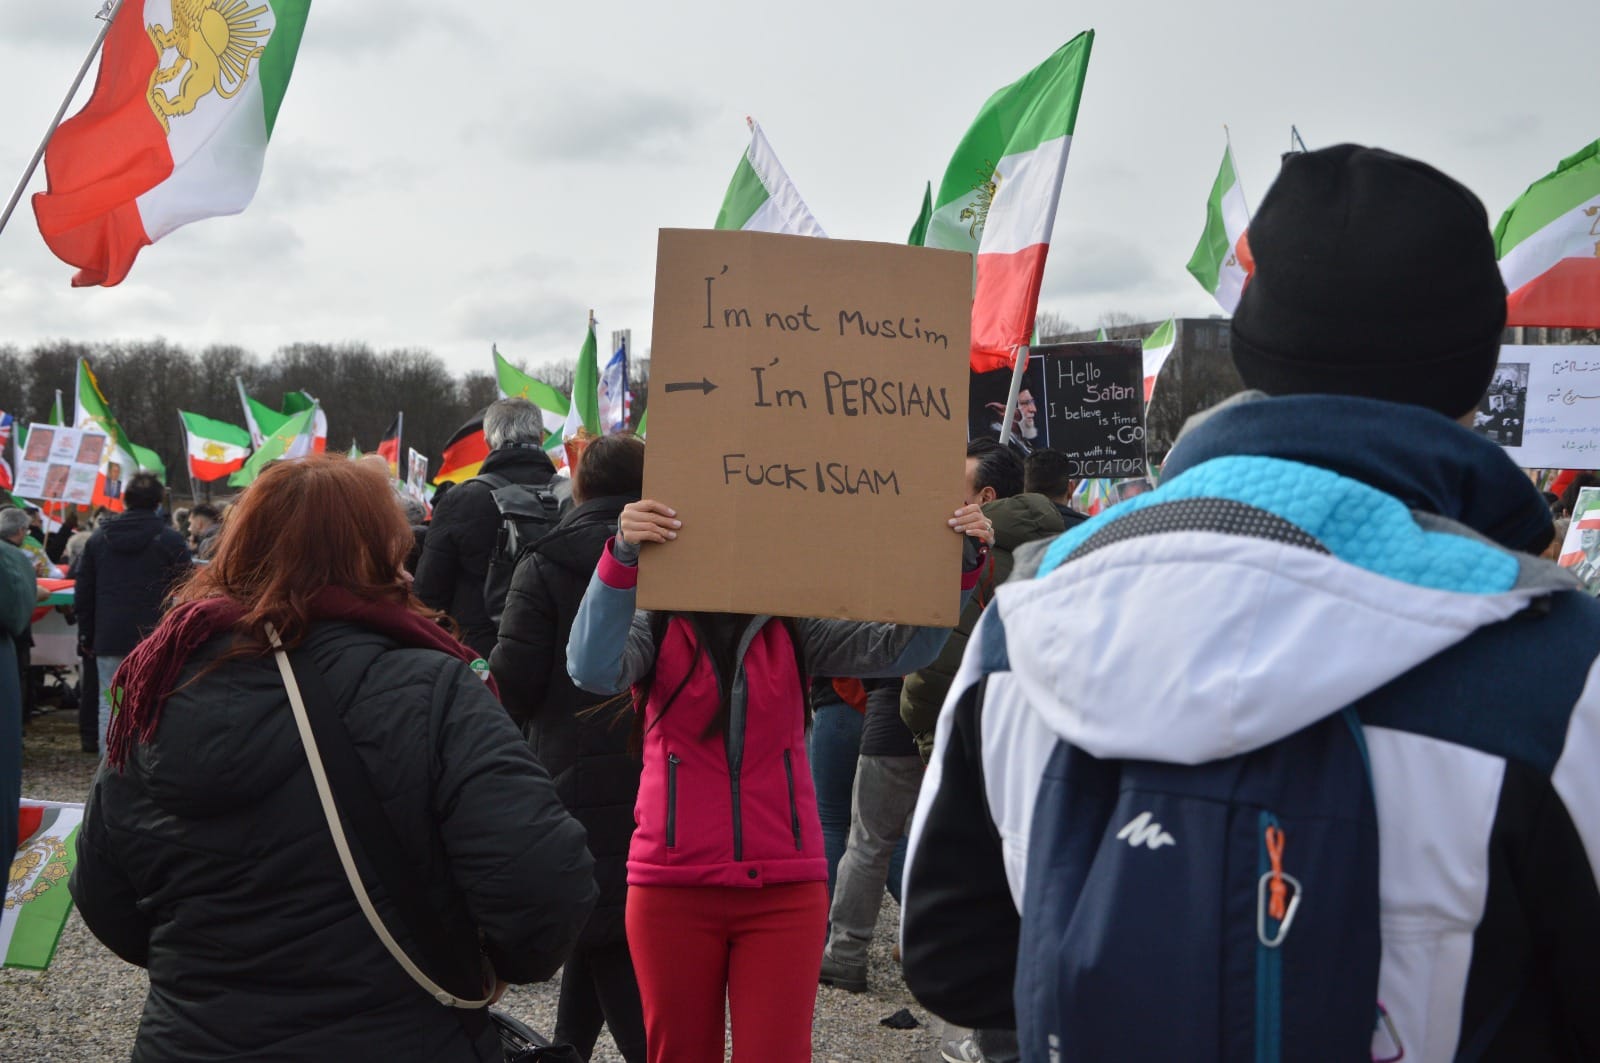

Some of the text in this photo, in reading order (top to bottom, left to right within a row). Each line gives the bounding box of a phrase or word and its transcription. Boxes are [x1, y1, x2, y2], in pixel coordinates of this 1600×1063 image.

[702, 265, 751, 328] I'm
[766, 305, 820, 332] not
[1058, 360, 1101, 389] Hello
[750, 357, 951, 420] I'm PERSIAN
[1083, 382, 1135, 403] Satan
[1050, 403, 1102, 420] I believe
[1099, 413, 1138, 426] is time
[1117, 425, 1145, 444] GO
[1084, 446, 1103, 457] with
[1105, 446, 1117, 456] the
[722, 453, 901, 496] FUCK ISLAM
